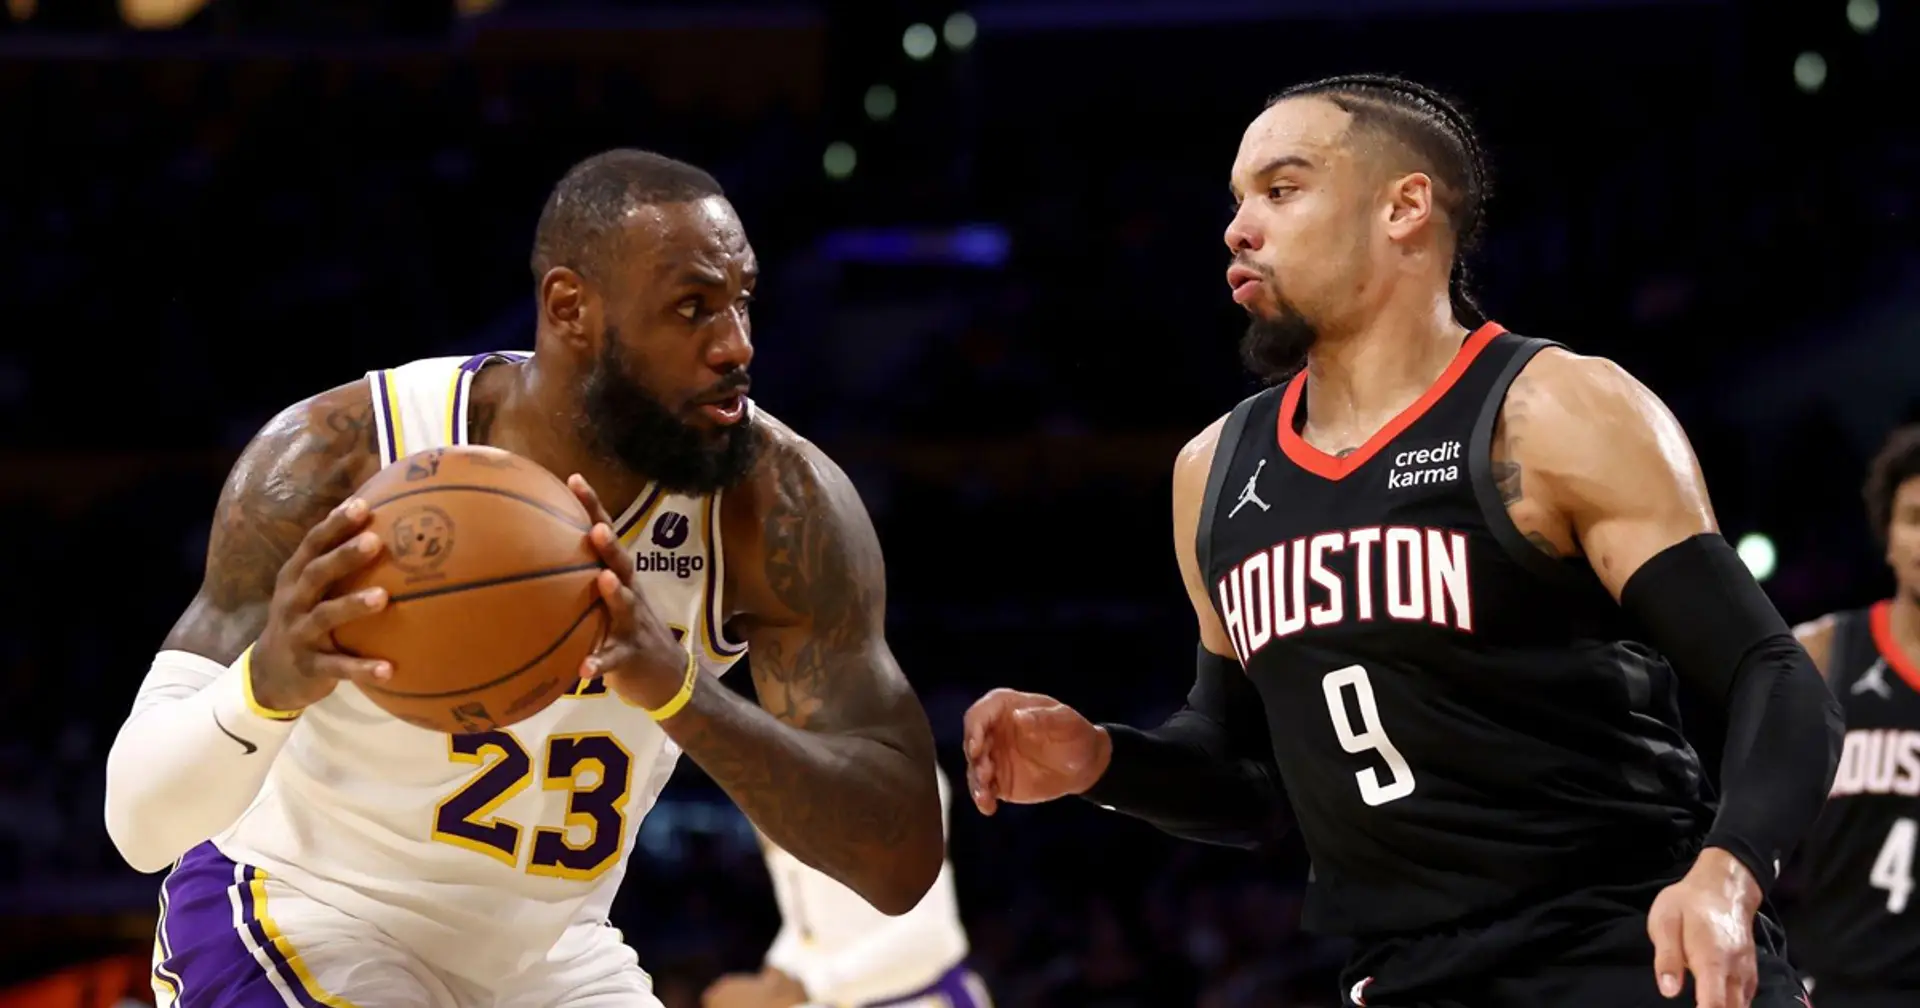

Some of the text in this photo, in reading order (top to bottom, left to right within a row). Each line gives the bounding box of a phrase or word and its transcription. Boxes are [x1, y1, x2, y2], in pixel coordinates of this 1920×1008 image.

[1388, 463, 1458, 489] karma
[1395, 440, 1461, 468] credit
[635, 551, 704, 578] bibigo
[1218, 526, 1473, 675] HOUSTON
[1322, 664, 1416, 807] 9
[1828, 729, 1920, 798] OUS
[431, 728, 635, 881] 23
[1869, 816, 1918, 914] 4
